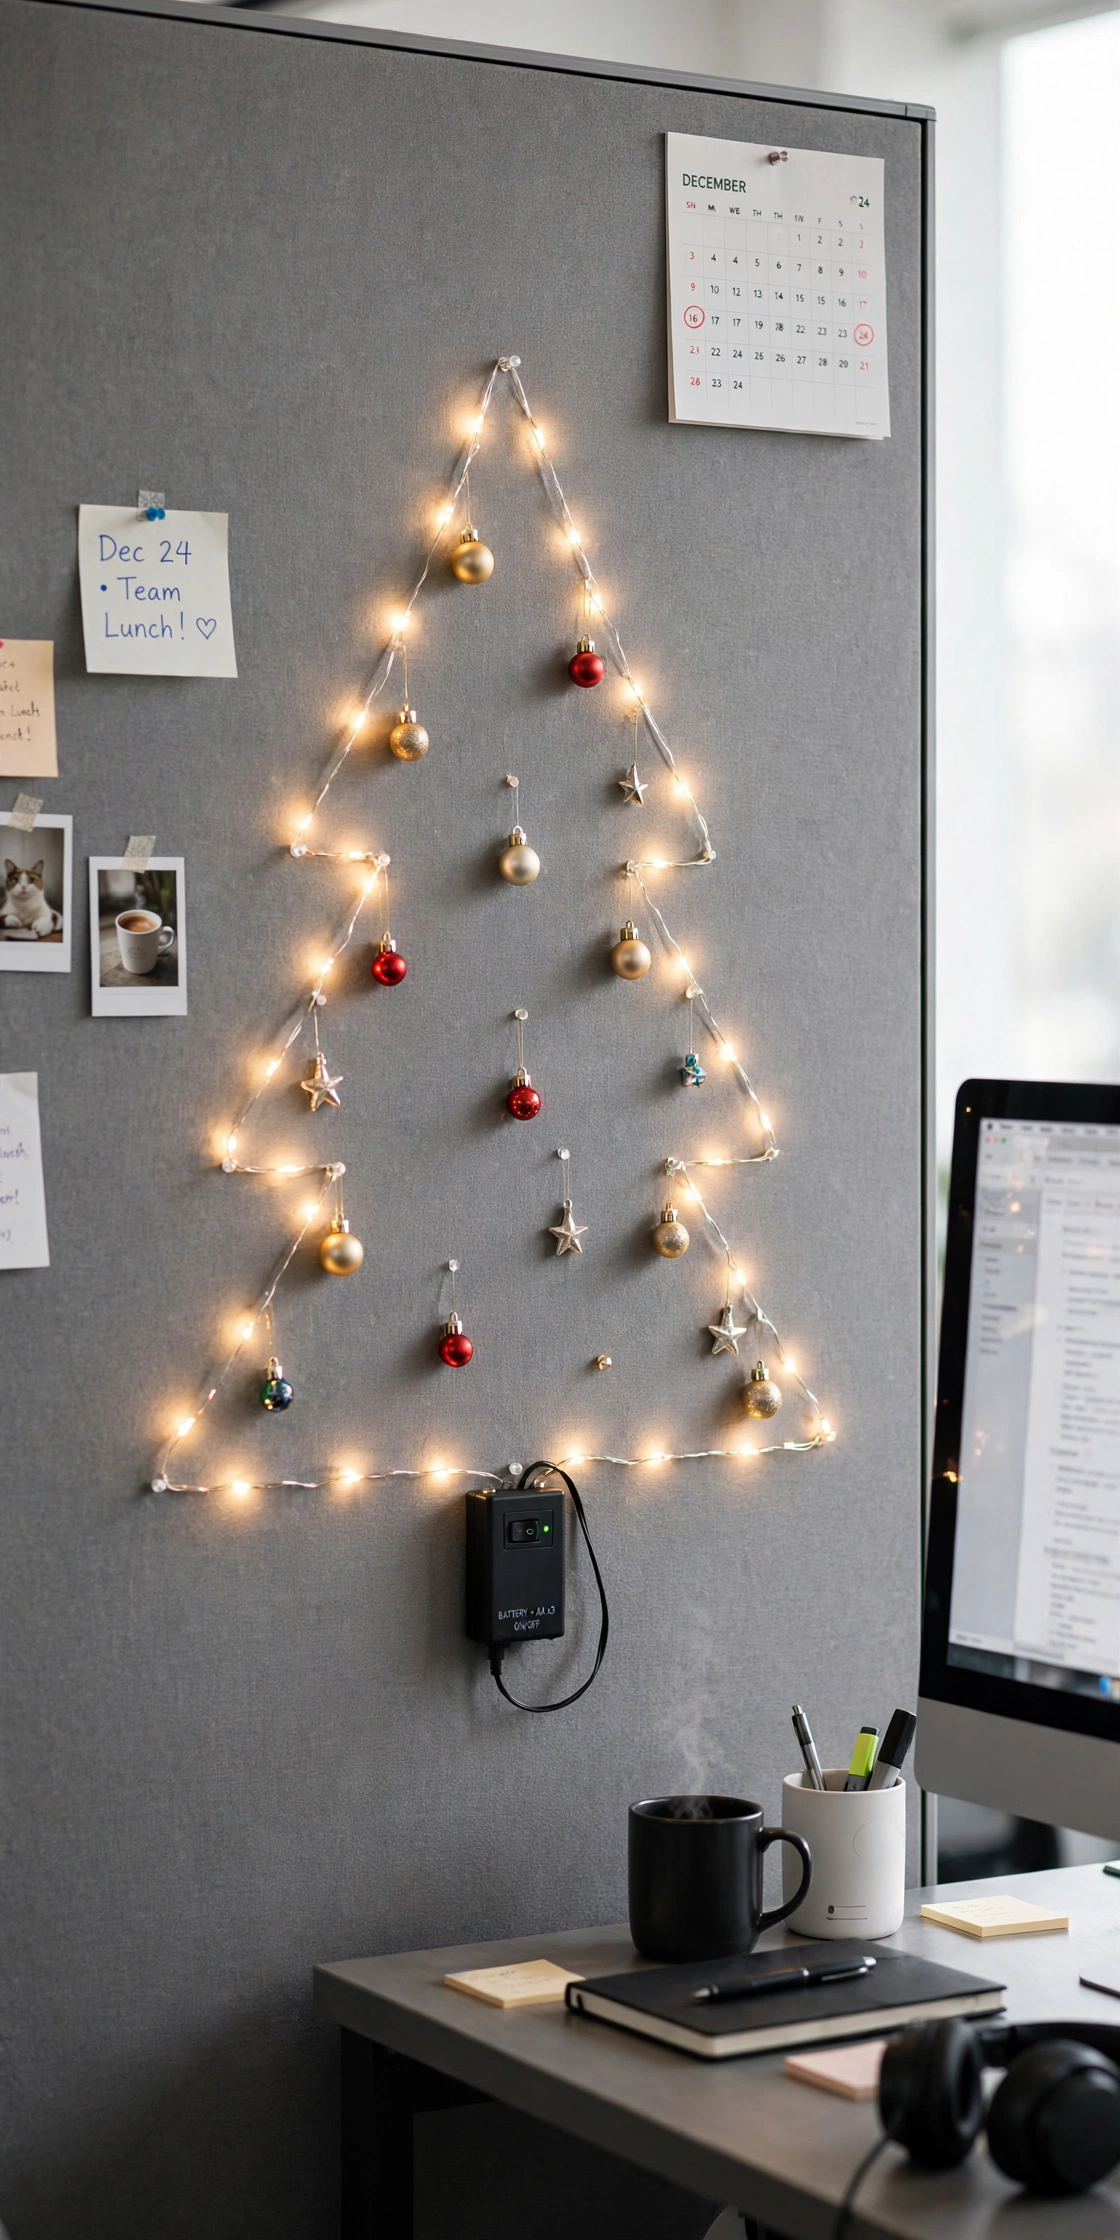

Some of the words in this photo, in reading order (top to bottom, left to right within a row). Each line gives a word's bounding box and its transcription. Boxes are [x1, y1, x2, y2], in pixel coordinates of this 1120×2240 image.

[682, 174, 746, 194] DECEMBER
[728, 206, 740, 214] WE
[774, 212, 782, 220] TH
[798, 234, 800, 242] 1
[818, 236, 822, 244] 2
[838, 238, 844, 246] 2
[858, 240, 864, 250] 3
[690, 252, 694, 260] 3
[710, 254, 716, 262] 4
[732, 256, 738, 264] 4
[754, 258, 760, 266] 5
[776, 262, 782, 270] 6
[796, 264, 802, 272] 7
[818, 266, 824, 274] 8
[838, 268, 844, 276] 9
[858, 270, 868, 280] 10
[690, 282, 696, 292] 9
[710, 284, 720, 294] 10
[732, 286, 742, 296] 12
[754, 290, 762, 298] 13
[774, 292, 784, 300] 14
[796, 294, 804, 302] 15
[818, 296, 826, 306] 15
[838, 298, 846, 308] 16
[688, 314, 698, 324] 16
[712, 316, 720, 326] 17
[732, 318, 742, 326] 17
[754, 320, 764, 330] 19
[796, 324, 806, 334] 22
[818, 326, 828, 336] 23
[838, 328, 848, 338] 23
[710, 348, 720, 356] 22
[732, 350, 742, 358] 24
[796, 356, 806, 364] 27
[734, 380, 742, 390] 24
[98, 534, 144, 562] Dec
[160, 540, 192, 566] 24
[116, 576, 180, 602] Team
[104, 612, 184, 640] Lunch!
[498, 1608, 528, 1620] BATTERY
